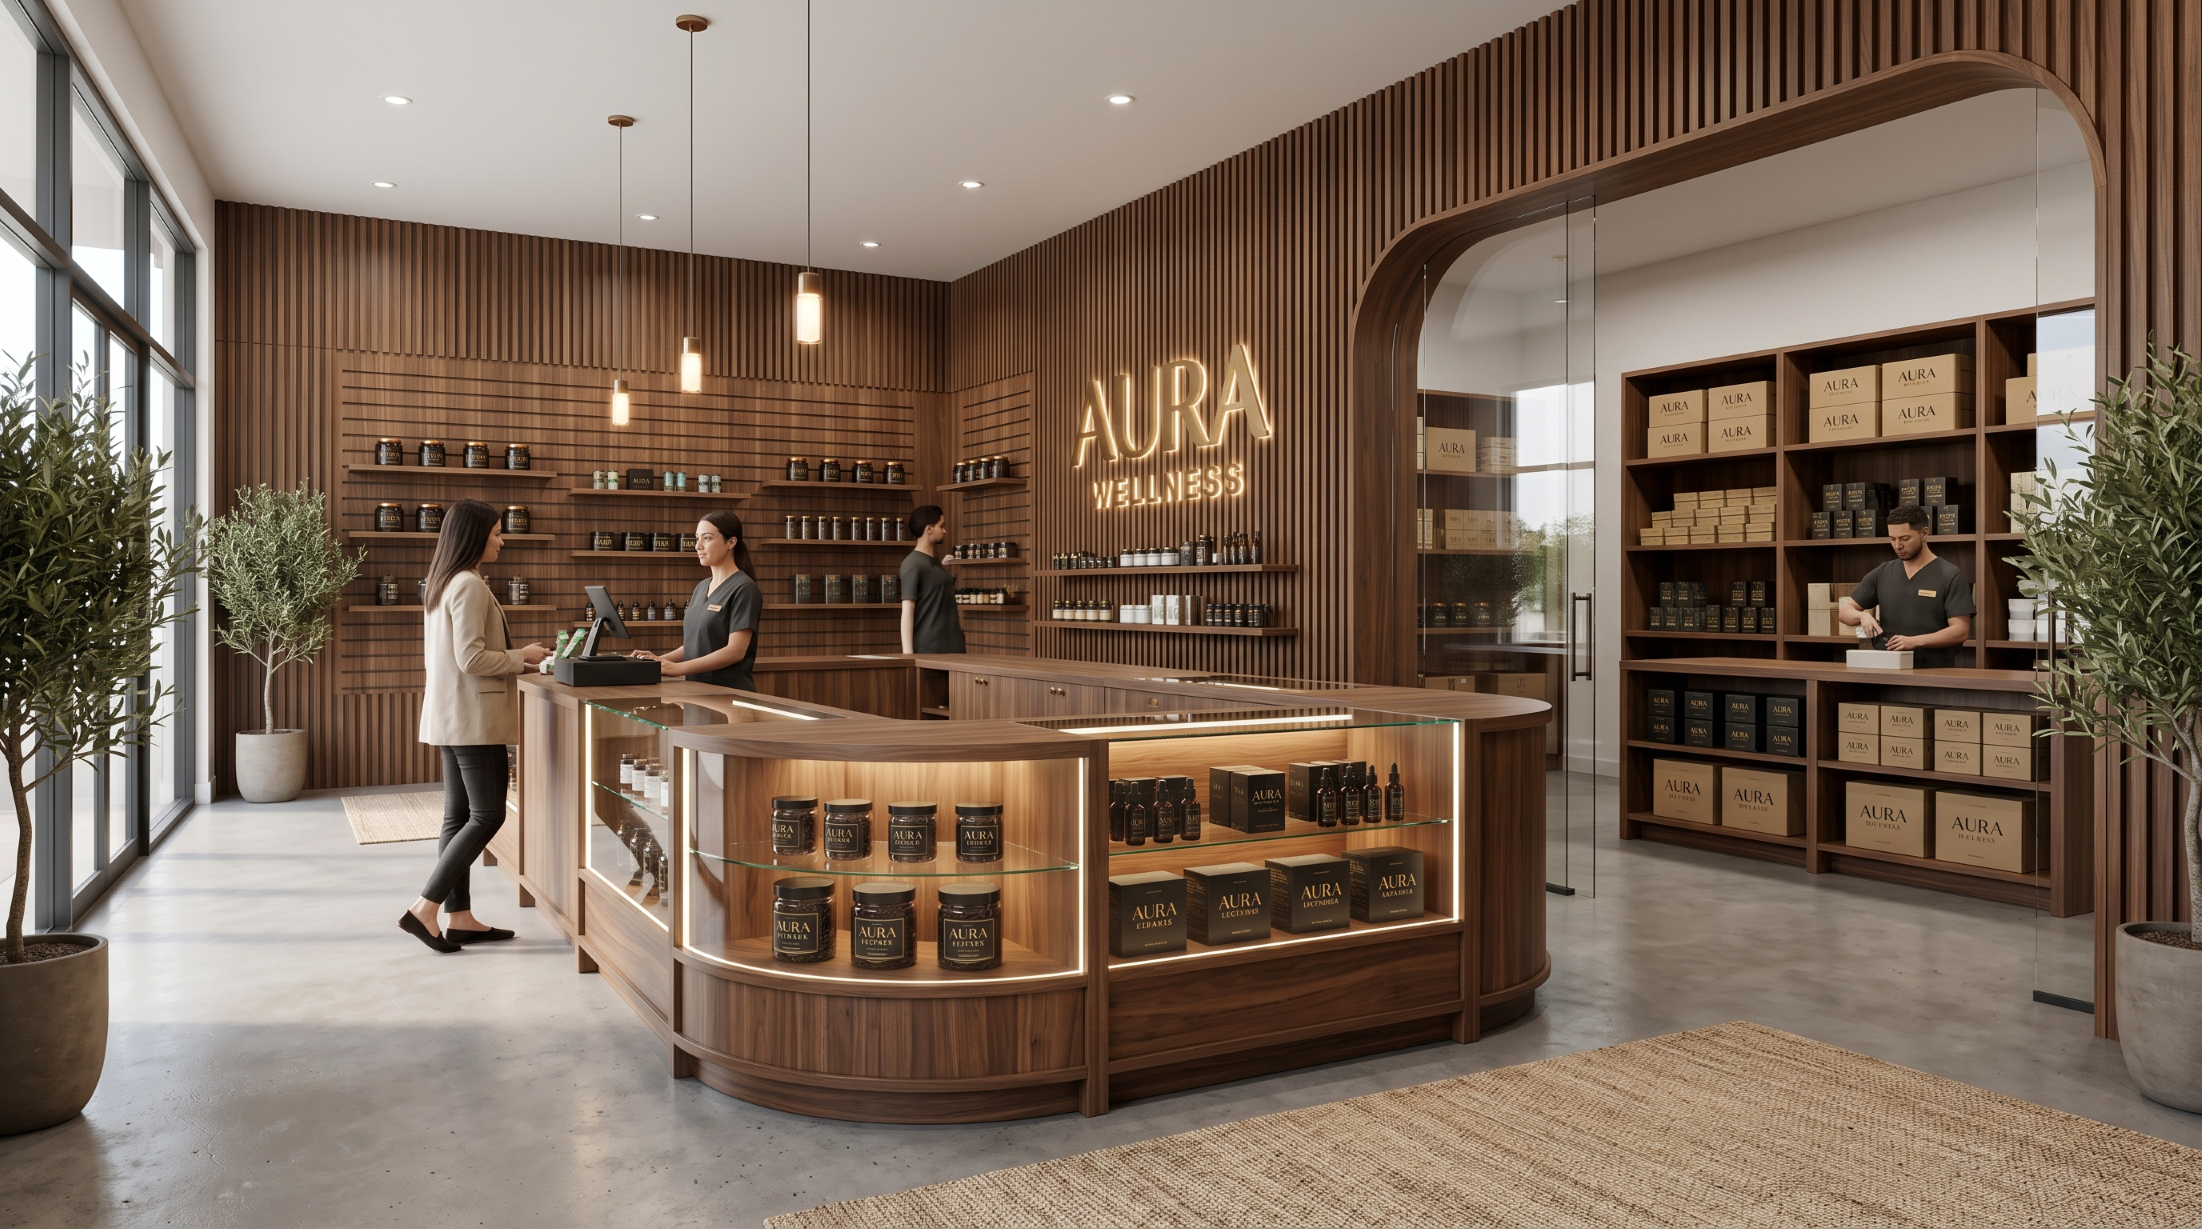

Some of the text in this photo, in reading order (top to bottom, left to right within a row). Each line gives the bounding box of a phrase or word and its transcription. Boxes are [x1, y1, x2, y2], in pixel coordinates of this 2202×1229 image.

[1897, 368, 1936, 382] AURA
[1823, 378, 1859, 392] AURA
[1071, 344, 1273, 468] AURA
[1721, 393, 1752, 406] AURA
[1660, 401, 1689, 413] AURA
[1897, 406, 1936, 420] AURA
[1823, 414, 1859, 428] AURA
[1659, 433, 1688, 444] AURA
[1721, 426, 1752, 439] AURA
[1439, 442, 1465, 454] AURA
[1093, 463, 1244, 510] WELLNESS
[1847, 712, 1868, 721] AURA
[1890, 715, 1913, 725] AURA
[1944, 720, 1969, 729] AURA
[1993, 723, 2020, 733] AURA
[1846, 741, 1868, 751] AURA
[1890, 746, 1913, 755] AURA
[1944, 751, 1969, 760] AURA
[1993, 755, 2020, 766] AURA
[1664, 779, 1700, 796] AURA
[1252, 788, 1282, 802] AURA
[1733, 788, 1774, 806] AURA
[1860, 805, 1907, 823] AURA
[826, 828, 853, 838] AURA
[1951, 816, 2003, 837] AURA
[893, 831, 922, 840] AURA
[964, 831, 994, 840] AURA
[1378, 873, 1416, 891] AURA
[1301, 882, 1342, 900] AURA
[1218, 892, 1262, 911] AURA
[1132, 902, 1178, 921] AURA
[776, 920, 811, 933] AURA
[859, 926, 896, 938] AURA
[949, 928, 988, 940] AURA
